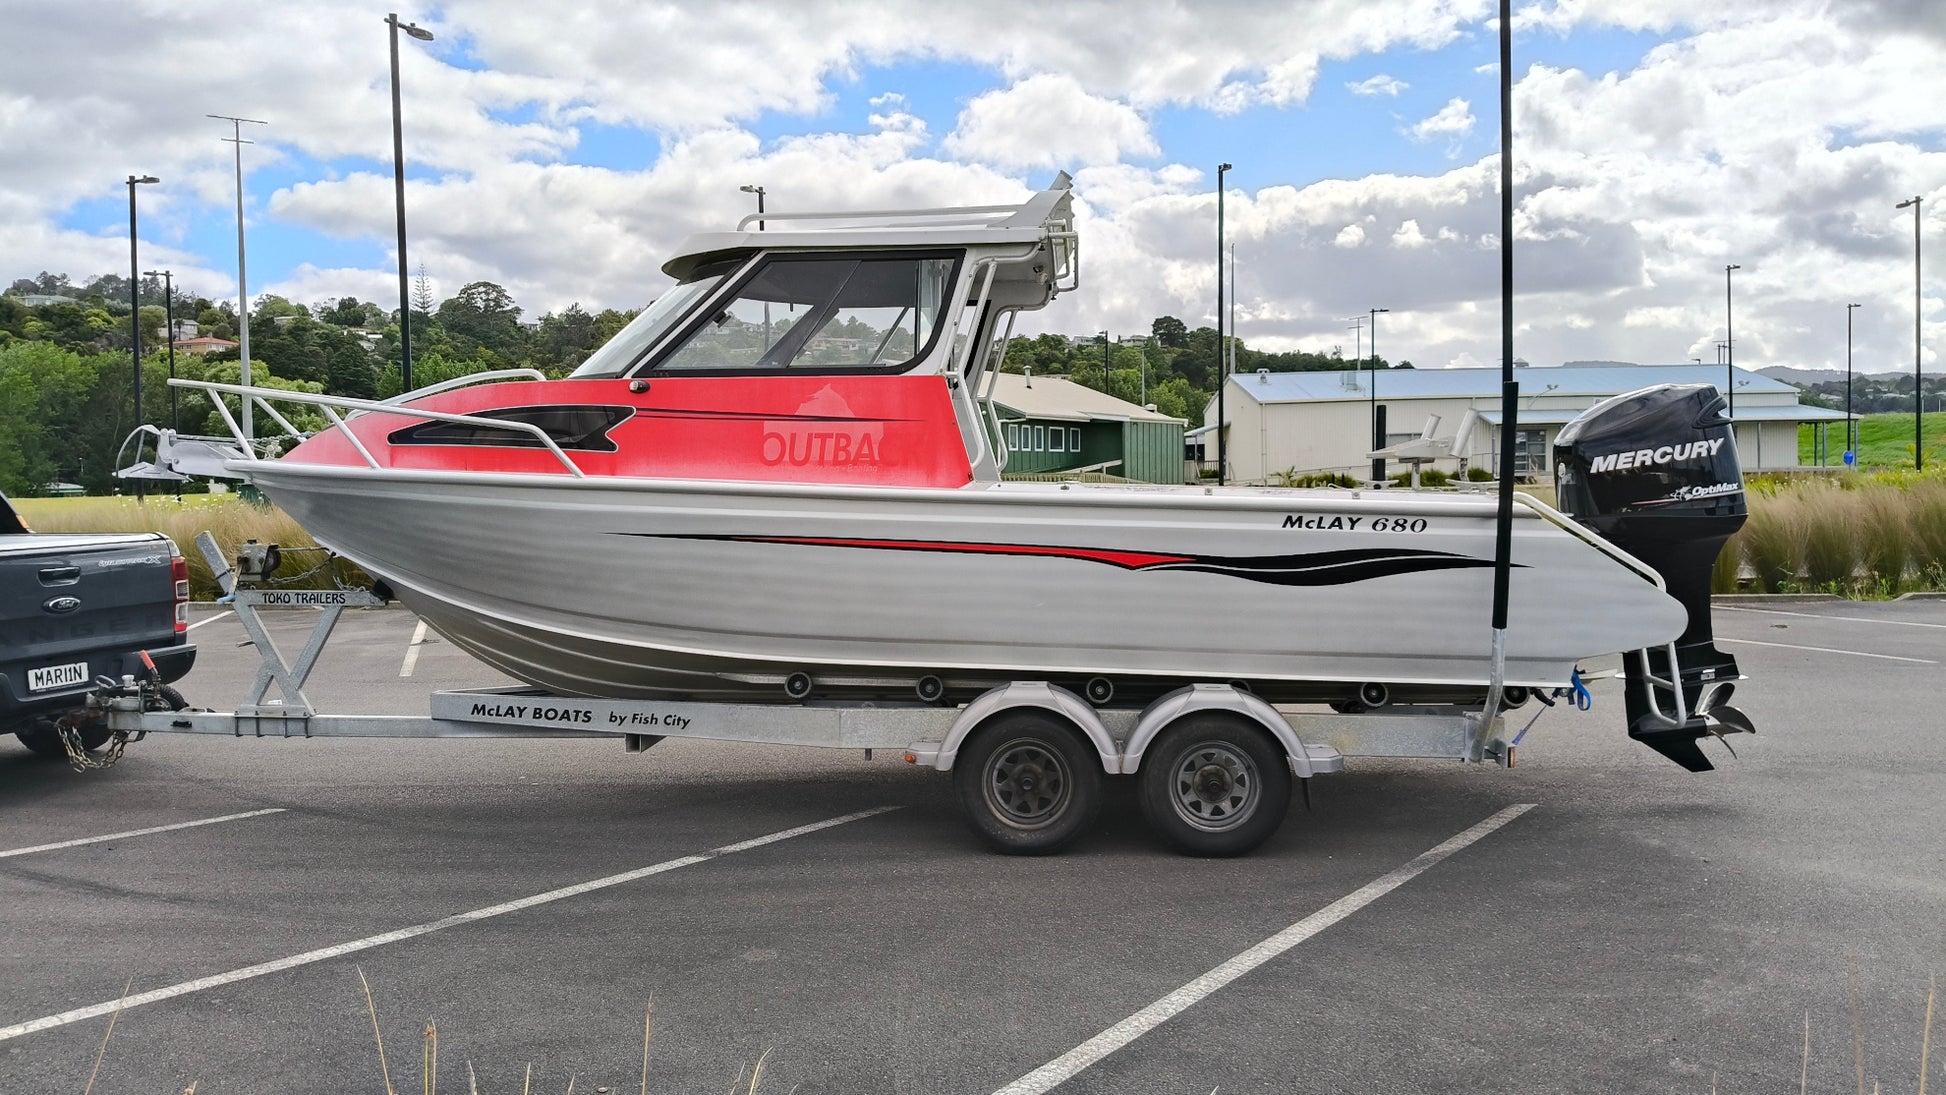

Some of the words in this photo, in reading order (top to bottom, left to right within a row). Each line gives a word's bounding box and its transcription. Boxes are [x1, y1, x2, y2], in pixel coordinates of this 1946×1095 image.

[1589, 437, 1725, 474] MERCURY
[1692, 482, 1739, 497] OptiMax
[1282, 515, 1363, 531] McLAY
[1371, 517, 1428, 533] 680
[262, 592, 291, 604] TOKO
[294, 592, 346, 604] TRAILERS
[471, 703, 528, 718] McLAY
[532, 707, 593, 723] BOATS
[608, 711, 627, 726] by
[631, 712, 659, 726] Fish
[663, 714, 692, 729] City
